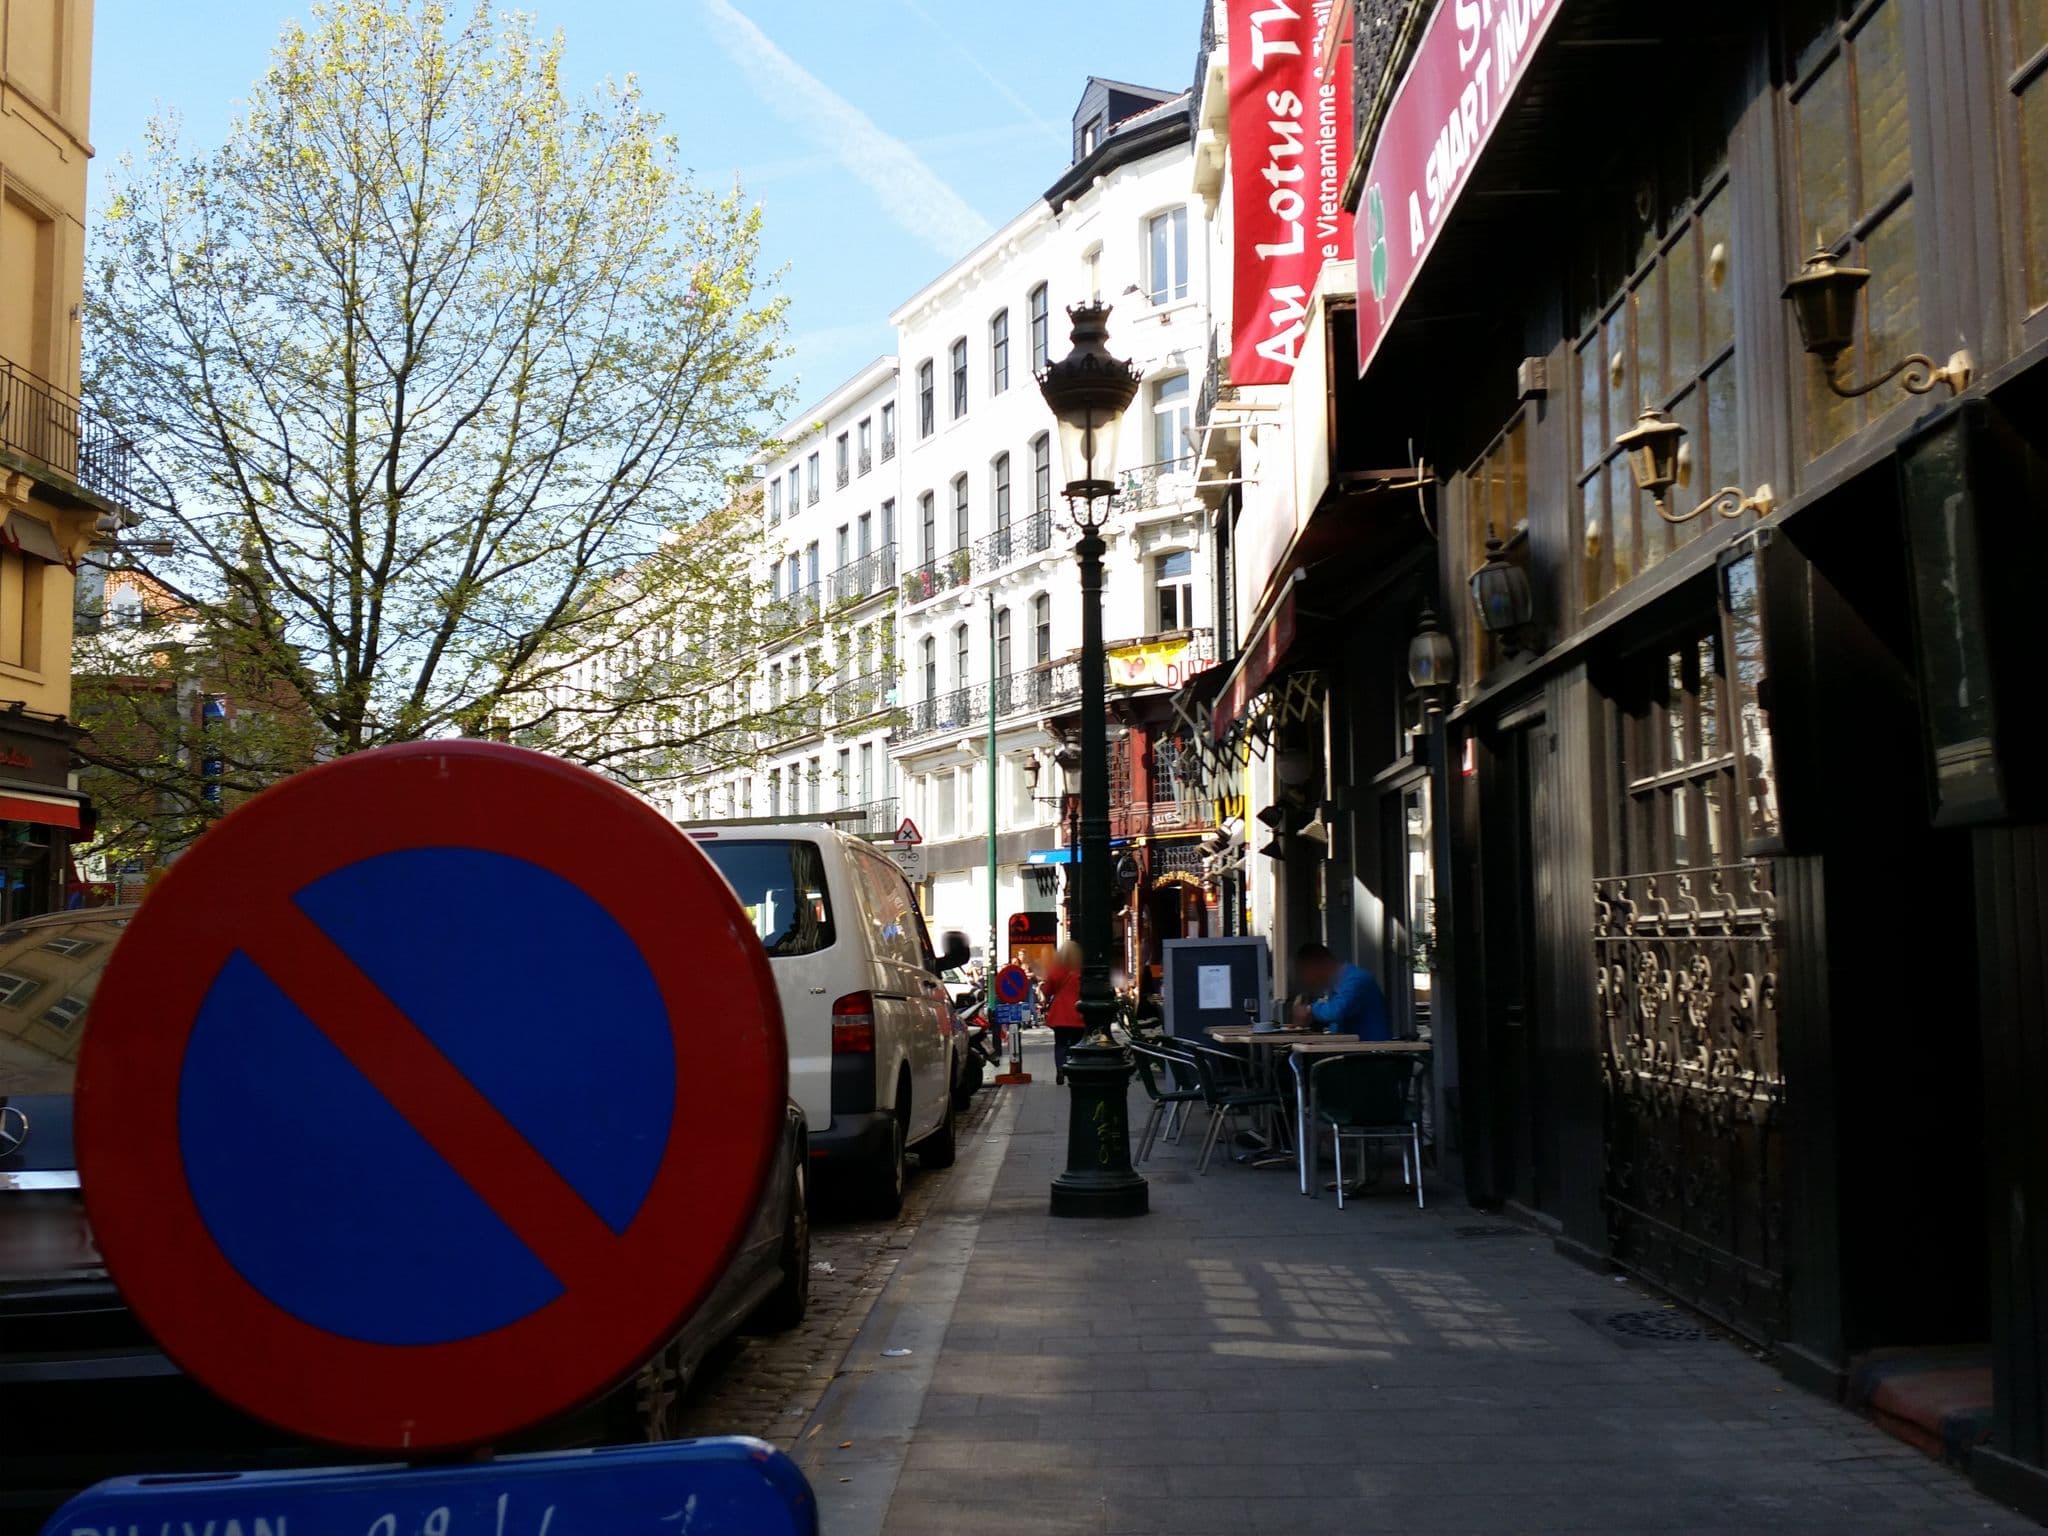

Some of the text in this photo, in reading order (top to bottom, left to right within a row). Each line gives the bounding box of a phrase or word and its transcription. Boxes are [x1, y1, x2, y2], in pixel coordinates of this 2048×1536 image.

[1455, 0, 1492, 71] S
[1254, 89, 1305, 261] Lotus
[1314, 84, 1339, 238] Vietnamienne
[1408, 190, 1425, 257] A
[1426, 47, 1491, 226] SMART
[1255, 284, 1307, 368] Au
